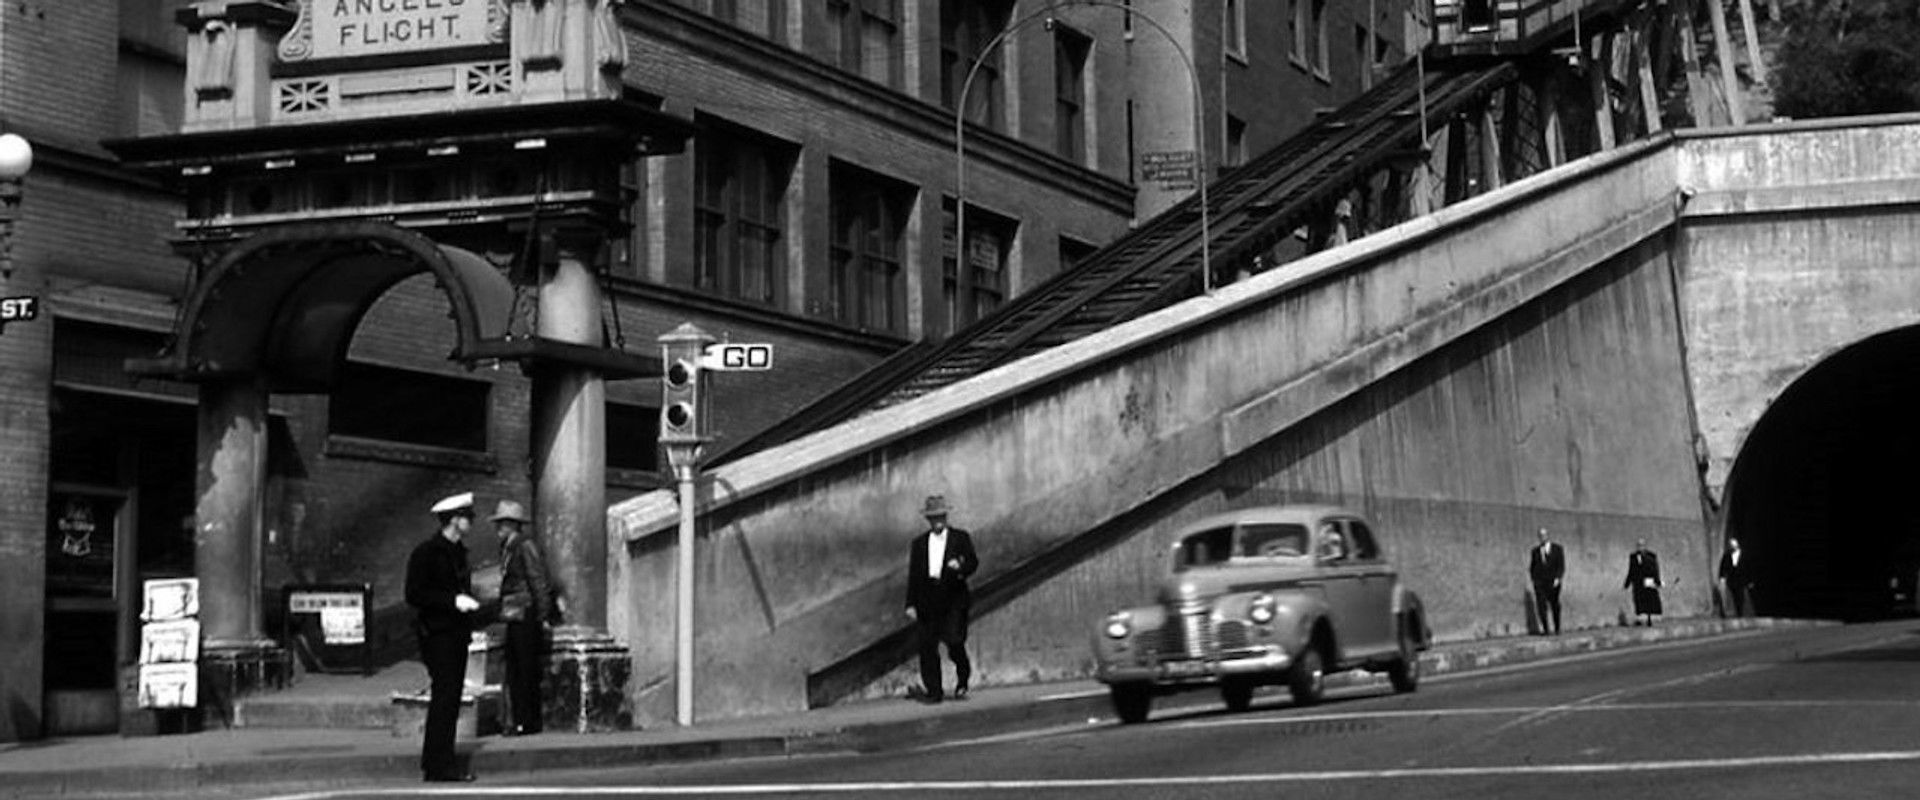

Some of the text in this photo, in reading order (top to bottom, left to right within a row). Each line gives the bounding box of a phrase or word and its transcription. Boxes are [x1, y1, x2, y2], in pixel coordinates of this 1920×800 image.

[334, 0, 464, 16] ANG
[2, 299, 33, 318] ST.
[724, 346, 769, 367] GO
